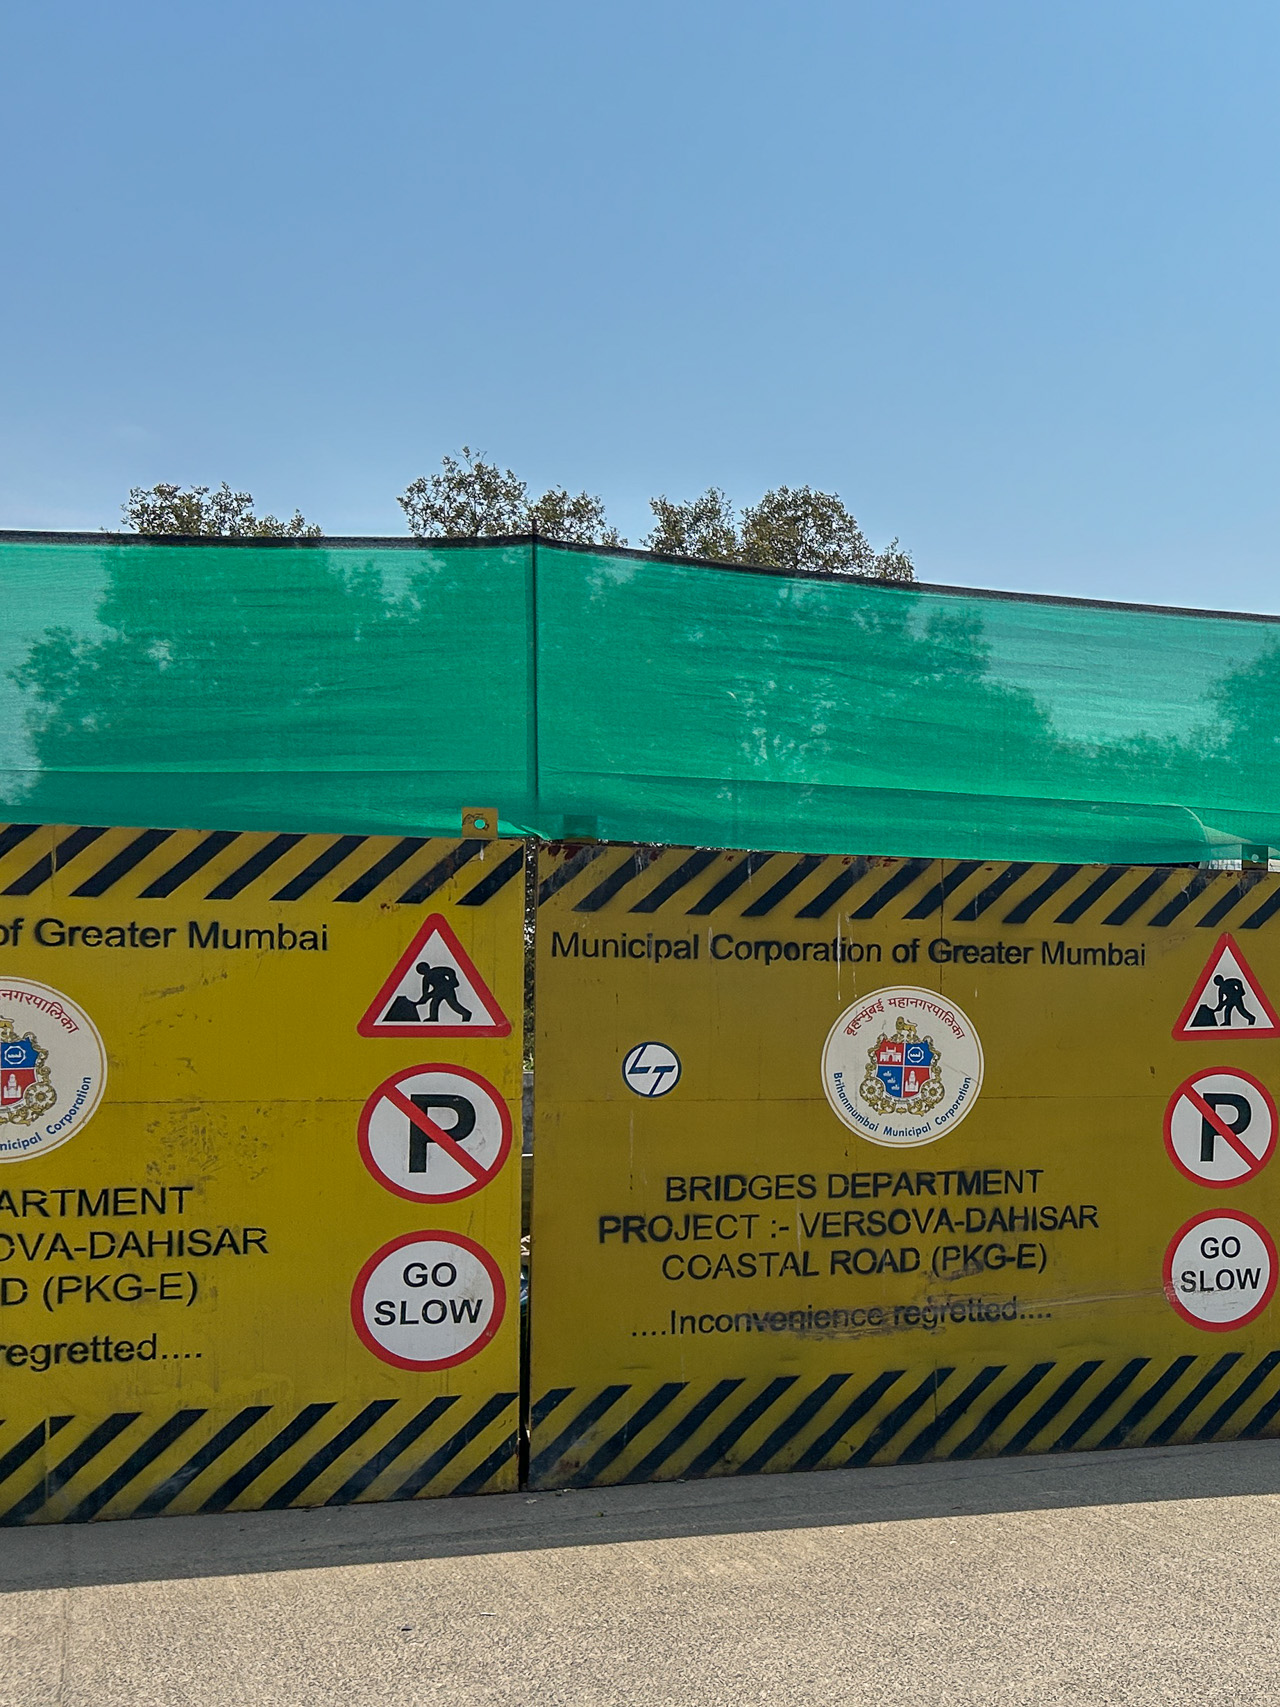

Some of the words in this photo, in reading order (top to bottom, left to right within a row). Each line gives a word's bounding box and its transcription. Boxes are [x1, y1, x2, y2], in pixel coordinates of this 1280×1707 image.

[34, 918, 177, 949] Greater
[188, 920, 328, 951] Mumbai
[551, 931, 699, 963] Municipal
[709, 934, 882, 966] Corporation
[892, 938, 921, 963] of
[927, 938, 1035, 965] Greater
[1041, 941, 1146, 967] Mumbai
[887, 996, 966, 1039] महानगरपालिका
[0, 1131, 43, 1150] nicipal
[46, 1076, 92, 1135] Corporation
[833, 1072, 880, 1132] Brihanmumbai
[883, 1122, 932, 1138] Municipal
[934, 1076, 972, 1126] Corporation
[408, 1093, 477, 1174] P
[1199, 1092, 1252, 1163] P
[665, 1174, 817, 1202] BRIDGES
[828, 1169, 1044, 1199] DEPARTMENT
[598, 1213, 760, 1244] PROJECT
[799, 1205, 1100, 1238] VERSOVA-DAHISAR
[661, 1251, 820, 1281] COASTAL
[830, 1247, 921, 1276] ROAD
[932, 1243, 1048, 1278] (PKG-E)
[1200, 1235, 1241, 1259] GO
[43, 1271, 199, 1312] (PKG-E)
[402, 1262, 457, 1288] GO
[1180, 1267, 1262, 1293] SLOW
[374, 1298, 484, 1326] SLOW
[0, 1333, 203, 1372] egretted....
